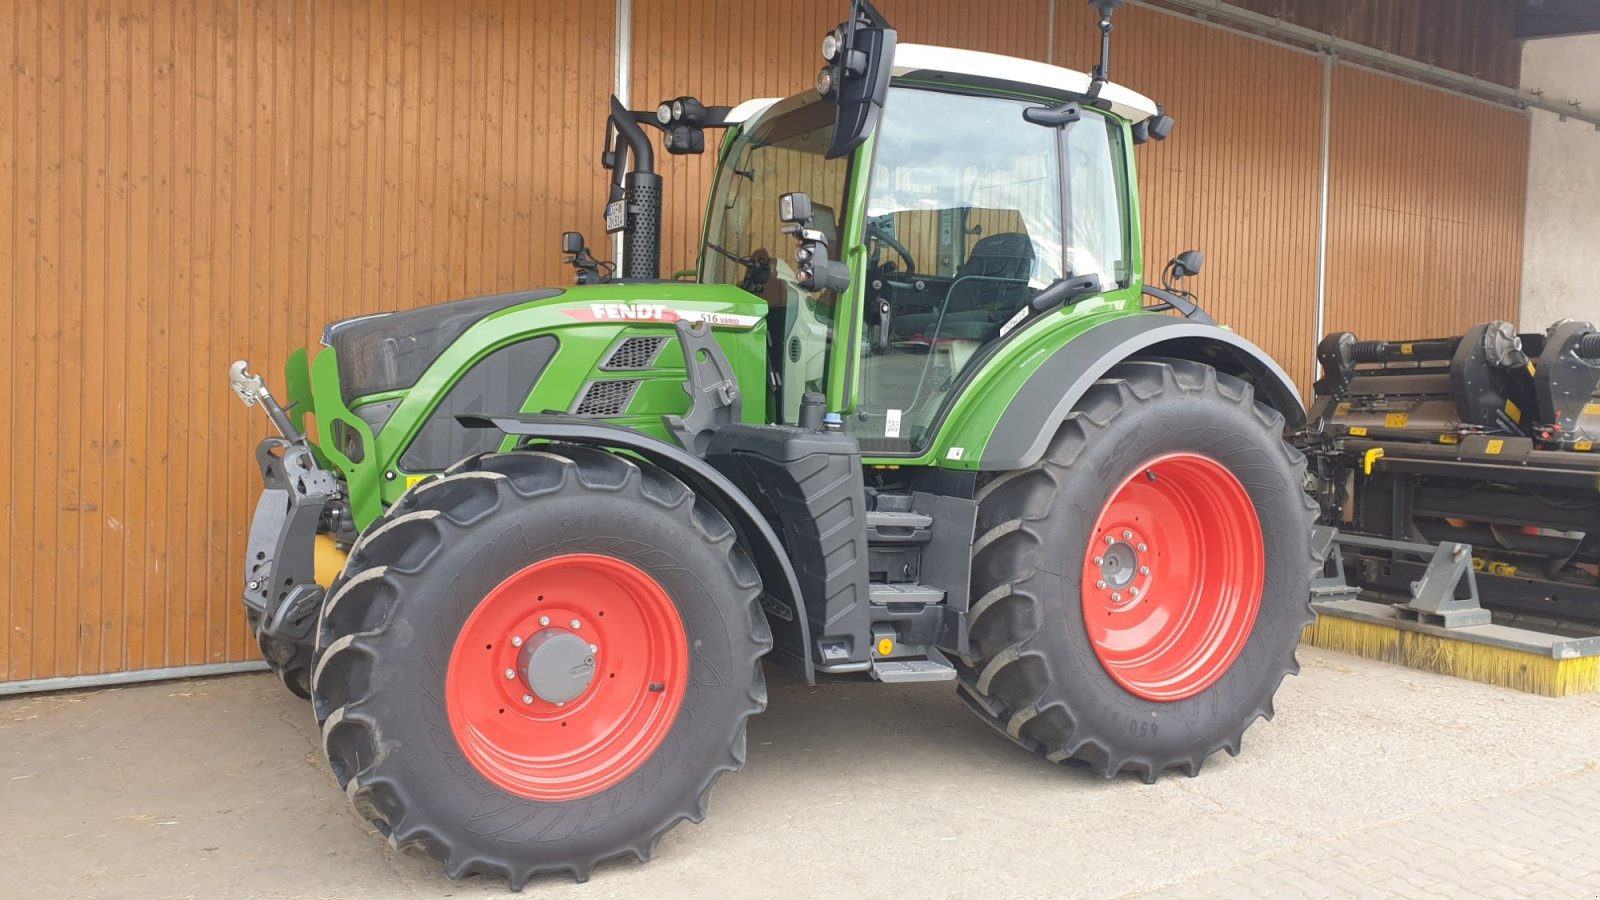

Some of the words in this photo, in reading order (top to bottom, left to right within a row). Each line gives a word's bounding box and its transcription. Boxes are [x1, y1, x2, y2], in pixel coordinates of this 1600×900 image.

[590, 303, 667, 320] FENDT
[701, 313, 718, 323] 516
[720, 317, 739, 325] VARIO
